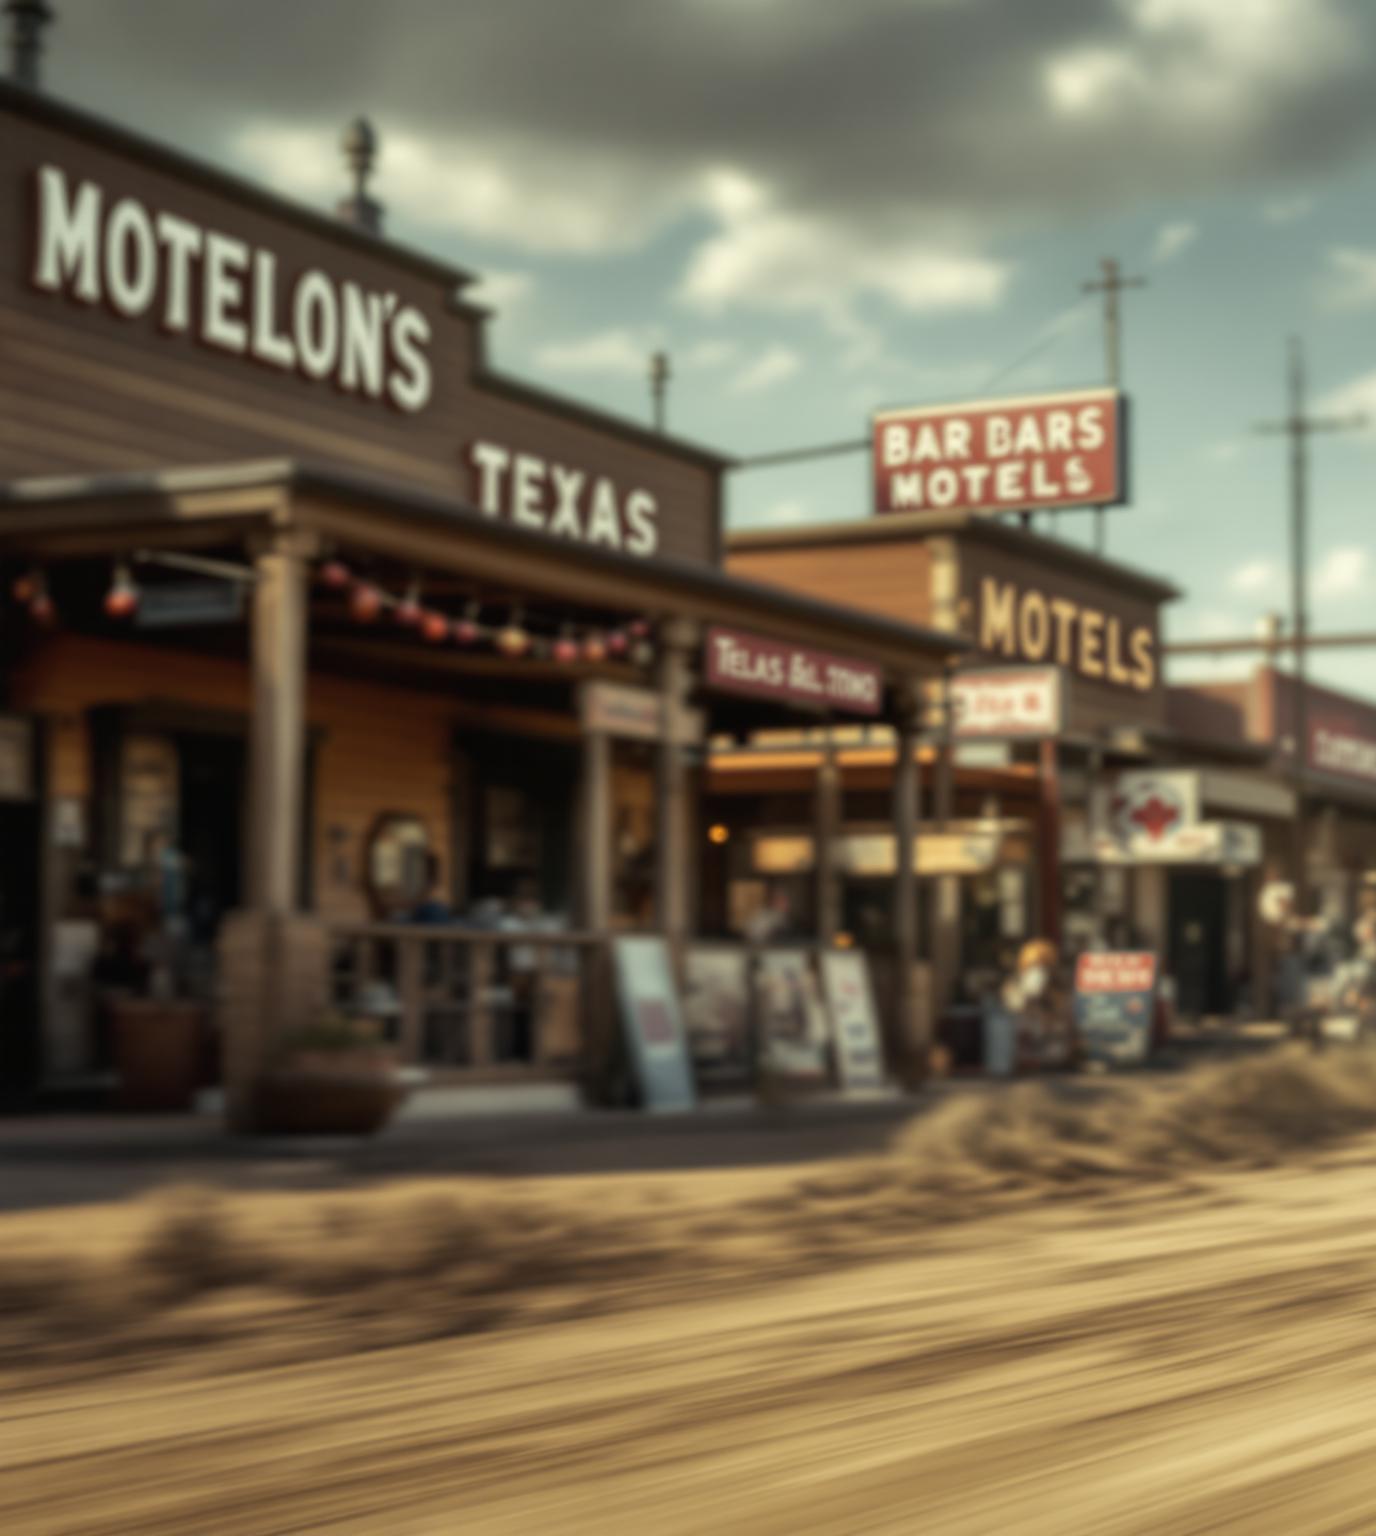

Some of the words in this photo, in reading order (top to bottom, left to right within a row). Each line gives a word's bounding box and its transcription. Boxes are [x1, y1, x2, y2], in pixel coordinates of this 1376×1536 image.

[34, 165, 432, 412] MOTELON'S
[473, 442, 658, 557] TEXAS
[883, 421, 971, 467] BAR
[891, 456, 1093, 508] MOTELS
[980, 576, 1154, 690] MOTELS
